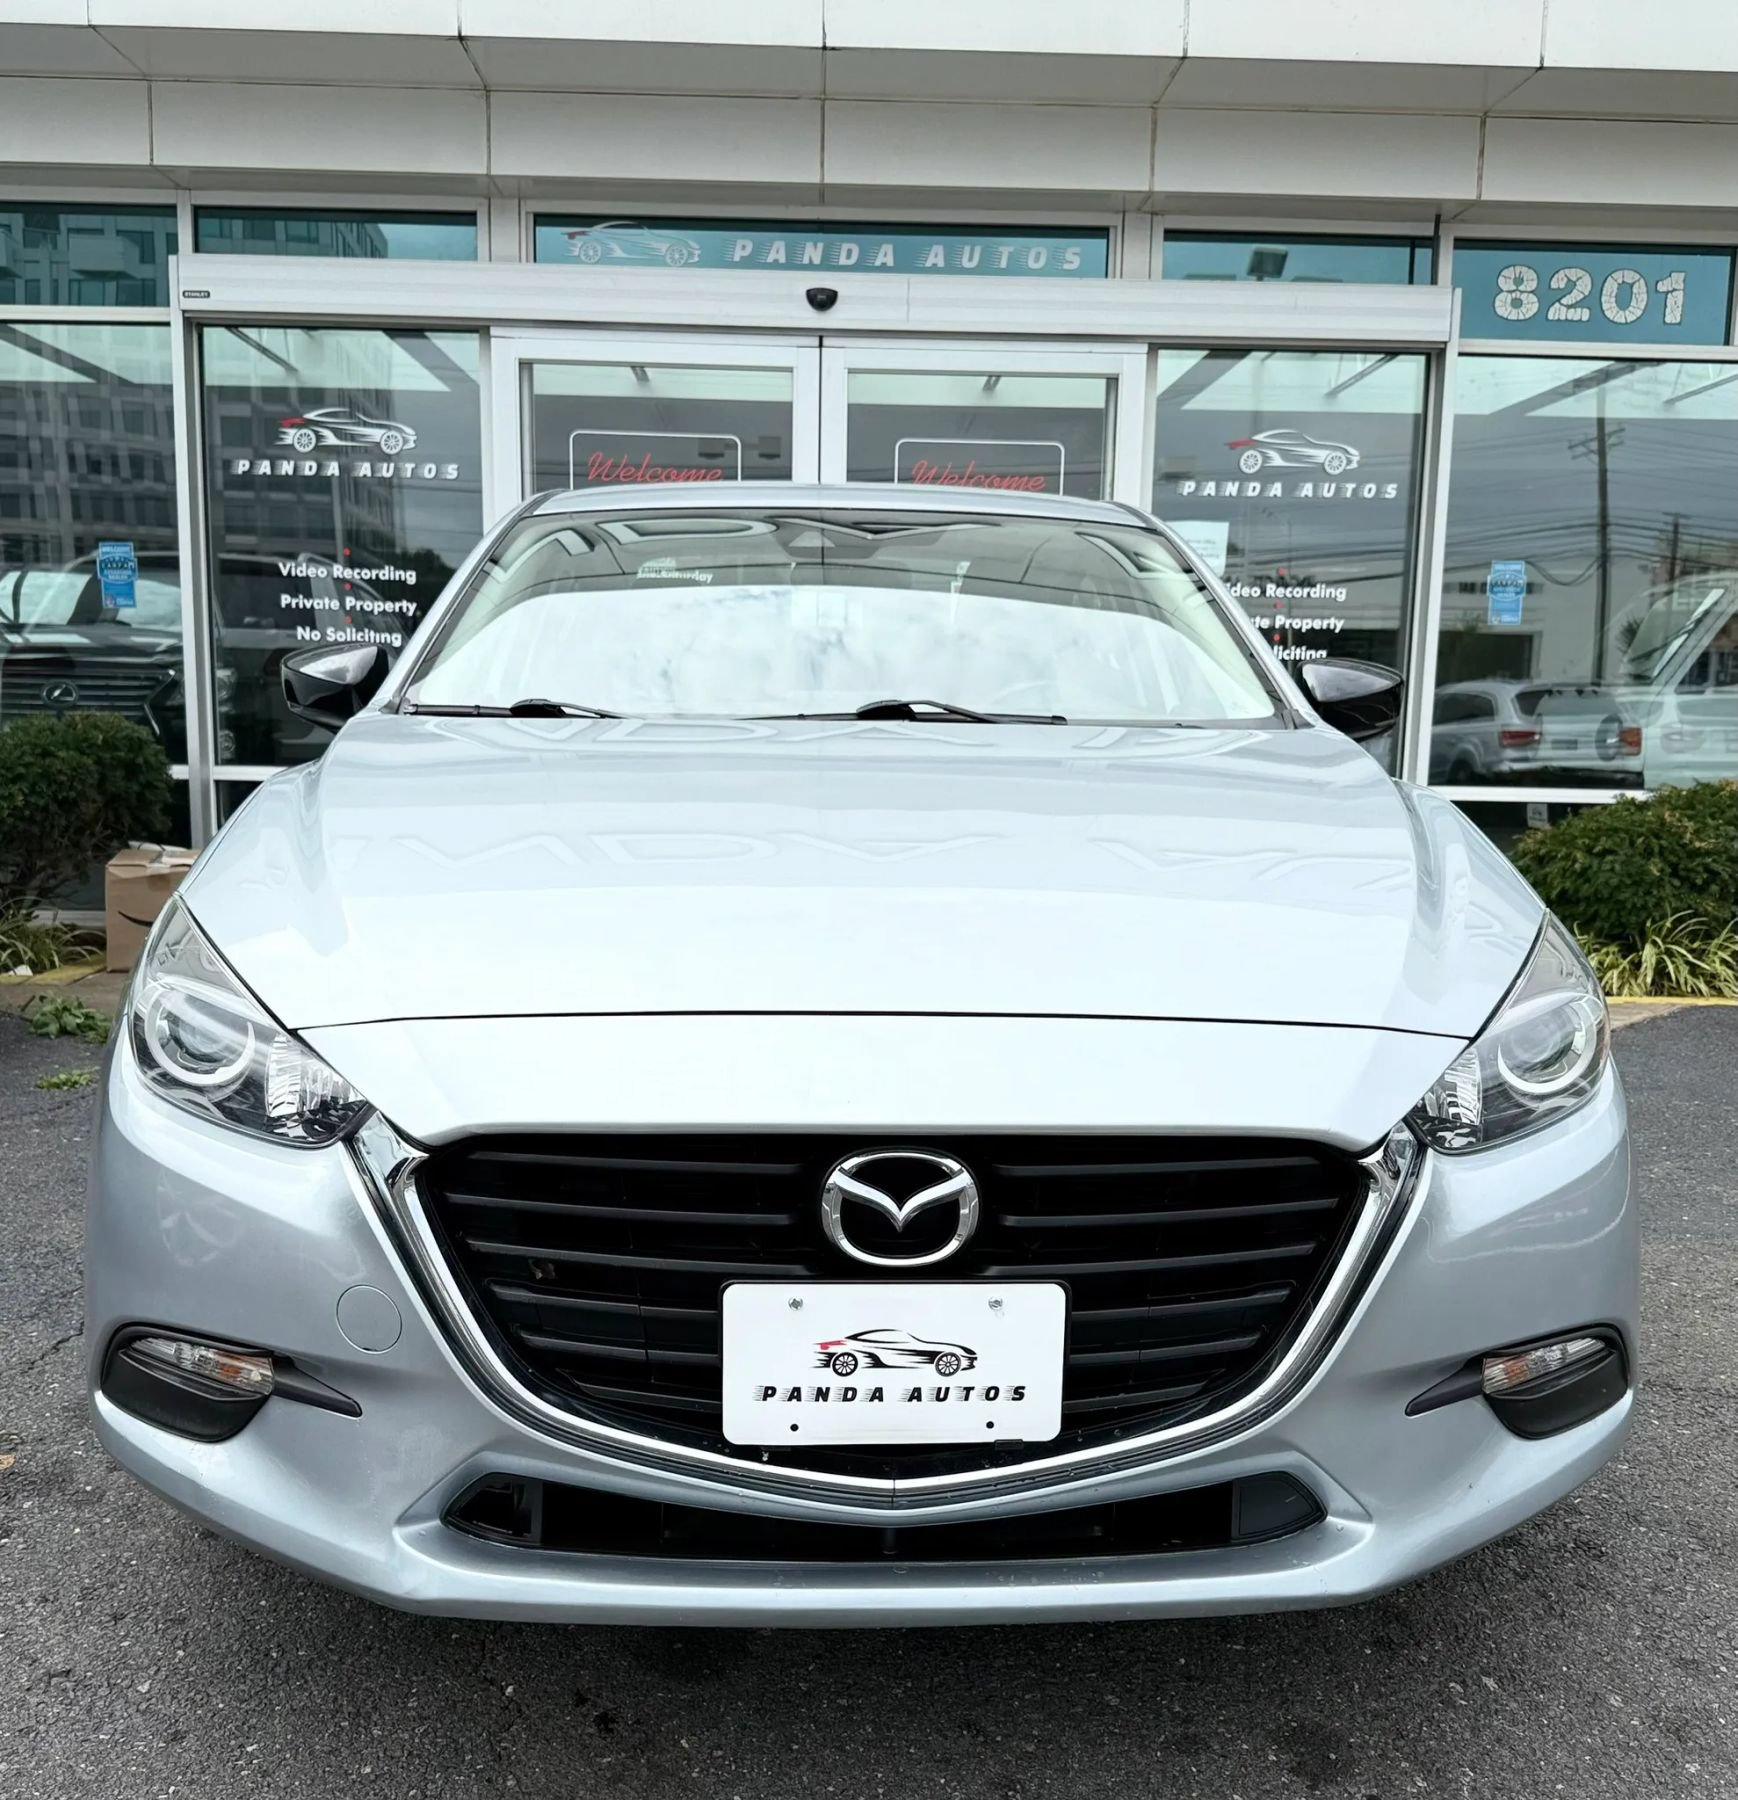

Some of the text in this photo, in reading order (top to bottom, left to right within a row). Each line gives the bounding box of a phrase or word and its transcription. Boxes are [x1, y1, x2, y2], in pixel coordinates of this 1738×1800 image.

[722, 238, 1082, 272] PANDA AUTOS
[1493, 264, 1686, 326] 8201
[233, 459, 459, 479] PANDA AUTOS
[586, 451, 724, 484] Welcome
[911, 459, 1046, 491] Welcome
[1179, 481, 1399, 499] PANDA AUTOS
[278, 562, 417, 585] Video Recording
[1227, 582, 1347, 602] ideo Recording
[280, 594, 418, 616] Private Property
[1274, 614, 1345, 633] Property
[296, 626, 402, 647] No Soliciting
[1272, 645, 1328, 661] licitin
[754, 1385, 1026, 1403] PANDA AUTOS
